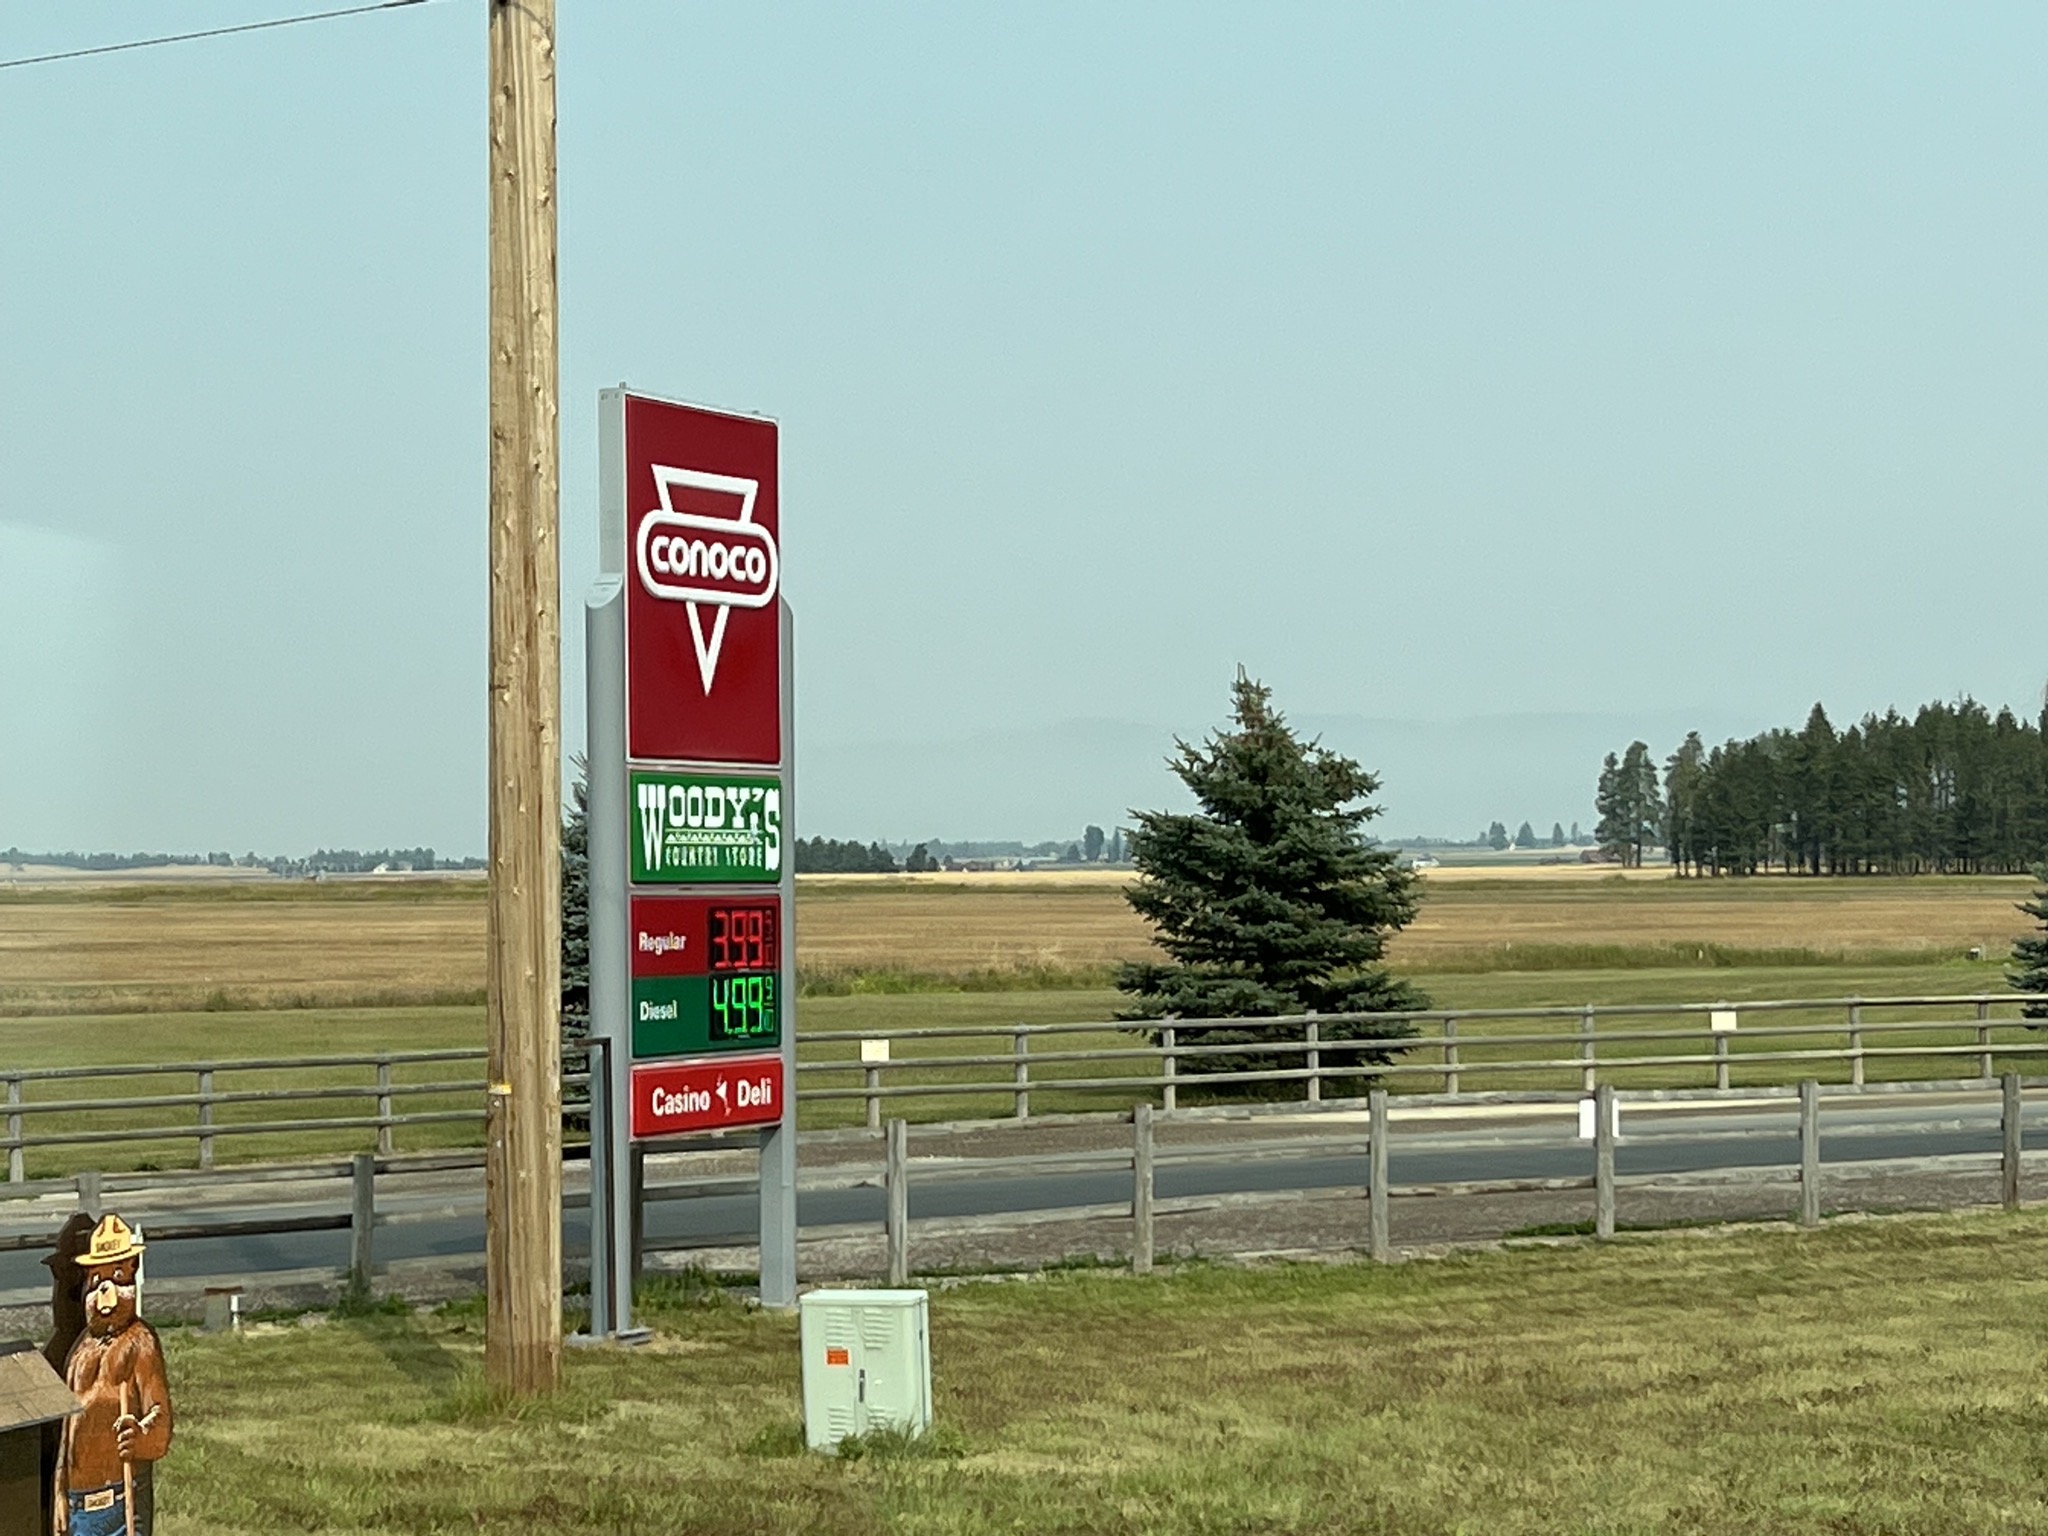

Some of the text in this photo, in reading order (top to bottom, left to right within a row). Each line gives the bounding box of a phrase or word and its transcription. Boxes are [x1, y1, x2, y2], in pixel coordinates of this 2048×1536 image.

[637, 783, 780, 871] WOODY'S
[638, 931, 687, 955] Regular
[639, 1000, 678, 1021] Diesel
[652, 1077, 772, 1117] Casino Deli
